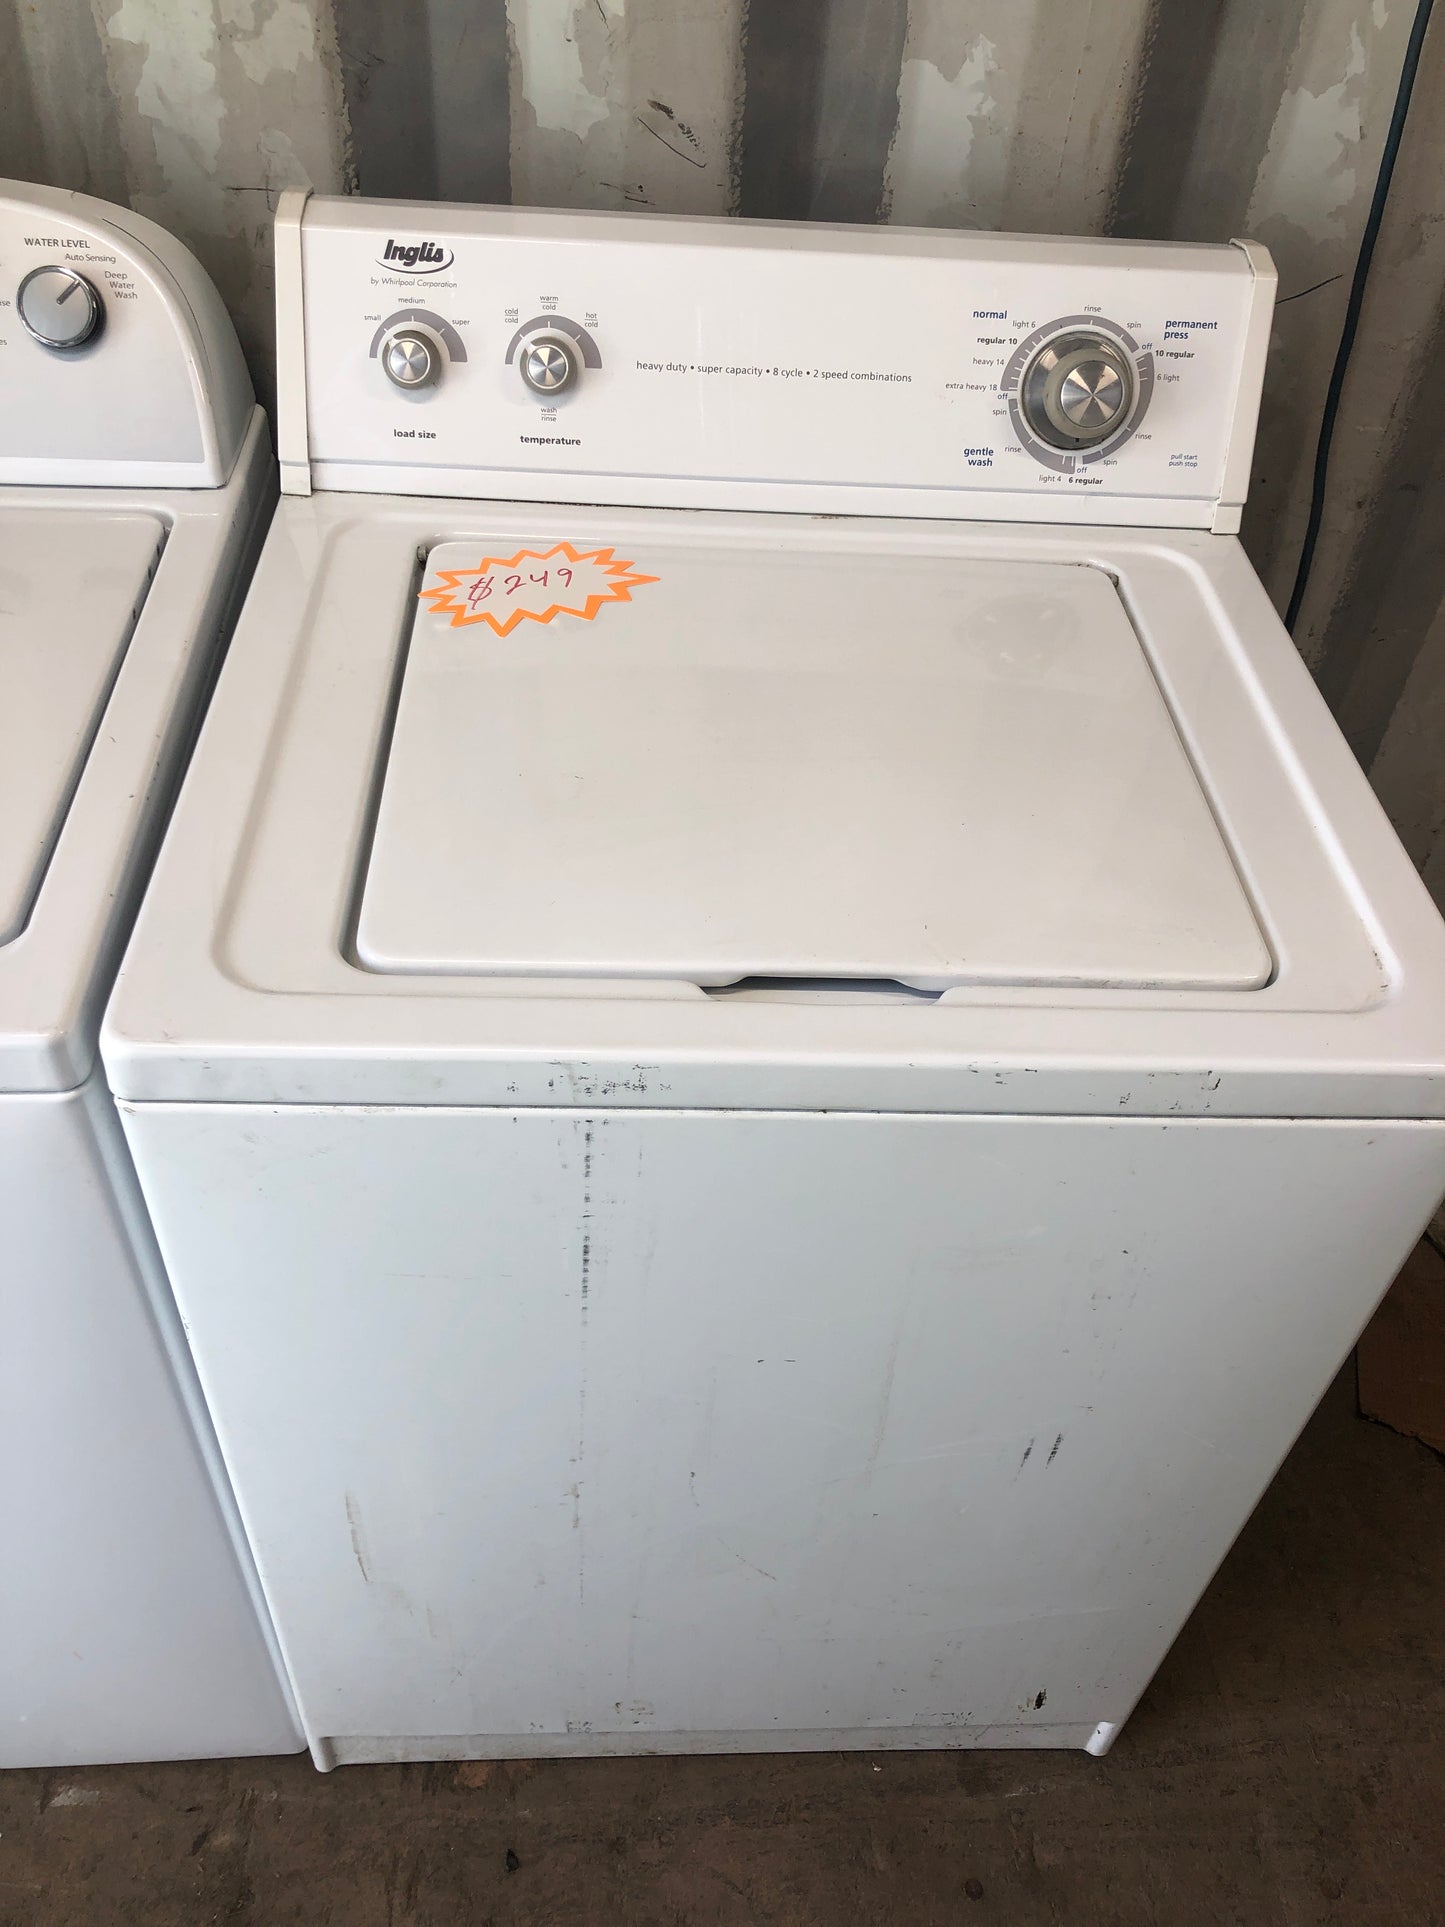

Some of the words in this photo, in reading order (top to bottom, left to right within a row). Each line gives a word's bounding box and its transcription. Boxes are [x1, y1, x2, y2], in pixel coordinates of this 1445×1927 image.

[24, 238, 59, 247] WATER
[61, 240, 90, 248] LEVEL
[383, 239, 444, 267] Inglis
[65, 253, 85, 262] Auto
[86, 254, 116, 264] Sensing
[104, 271, 127, 280] Deep
[109, 281, 135, 289] Water
[370, 277, 380, 286] by
[381, 278, 416, 287] Whirlpool
[416, 279, 458, 288] Corporation
[114, 291, 138, 299] Wash
[542, 303, 557, 311] cold
[1084, 304, 1102, 312] rinse
[973, 310, 1008, 320] normal
[1012, 320, 1031, 329] light
[1031, 321, 1036, 329] 6
[1126, 320, 1142, 329] spin
[1165, 320, 1218, 330] permanent
[1163, 331, 1189, 340] press
[977, 336, 1006, 345] regular
[1165, 350, 1195, 359] regular
[972, 357, 993, 366] heavy
[996, 358, 1005, 366] 14
[636, 360, 664, 373] heavy
[666, 362, 687, 374] duty
[697, 365, 723, 374] super
[725, 366, 763, 377] capacity
[772, 367, 779, 376] 8
[781, 368, 803, 378] cycle
[813, 369, 819, 378] 2
[821, 371, 848, 380] speed
[850, 371, 912, 382] combinations
[1156, 373, 1162, 381] 6
[1163, 373, 1180, 382] light
[945, 382, 964, 390] extra
[965, 383, 987, 391] heavy
[997, 392, 1008, 400] off
[992, 407, 1007, 416] spin
[541, 415, 557, 423] rinse
[393, 428, 416, 438] load
[417, 429, 437, 439] size
[1135, 432, 1152, 440] rinse
[520, 435, 582, 446] temperature
[963, 447, 994, 457] gentle
[1004, 445, 1022, 453] rinse
[1170, 453, 1183, 461] pull
[967, 458, 993, 467] wash
[1103, 459, 1118, 467] spin
[1076, 466, 1088, 474] off
[1039, 474, 1056, 484] light
[1056, 475, 1062, 483] 4
[1068, 476, 1074, 484] 6
[1075, 477, 1104, 486] regular
